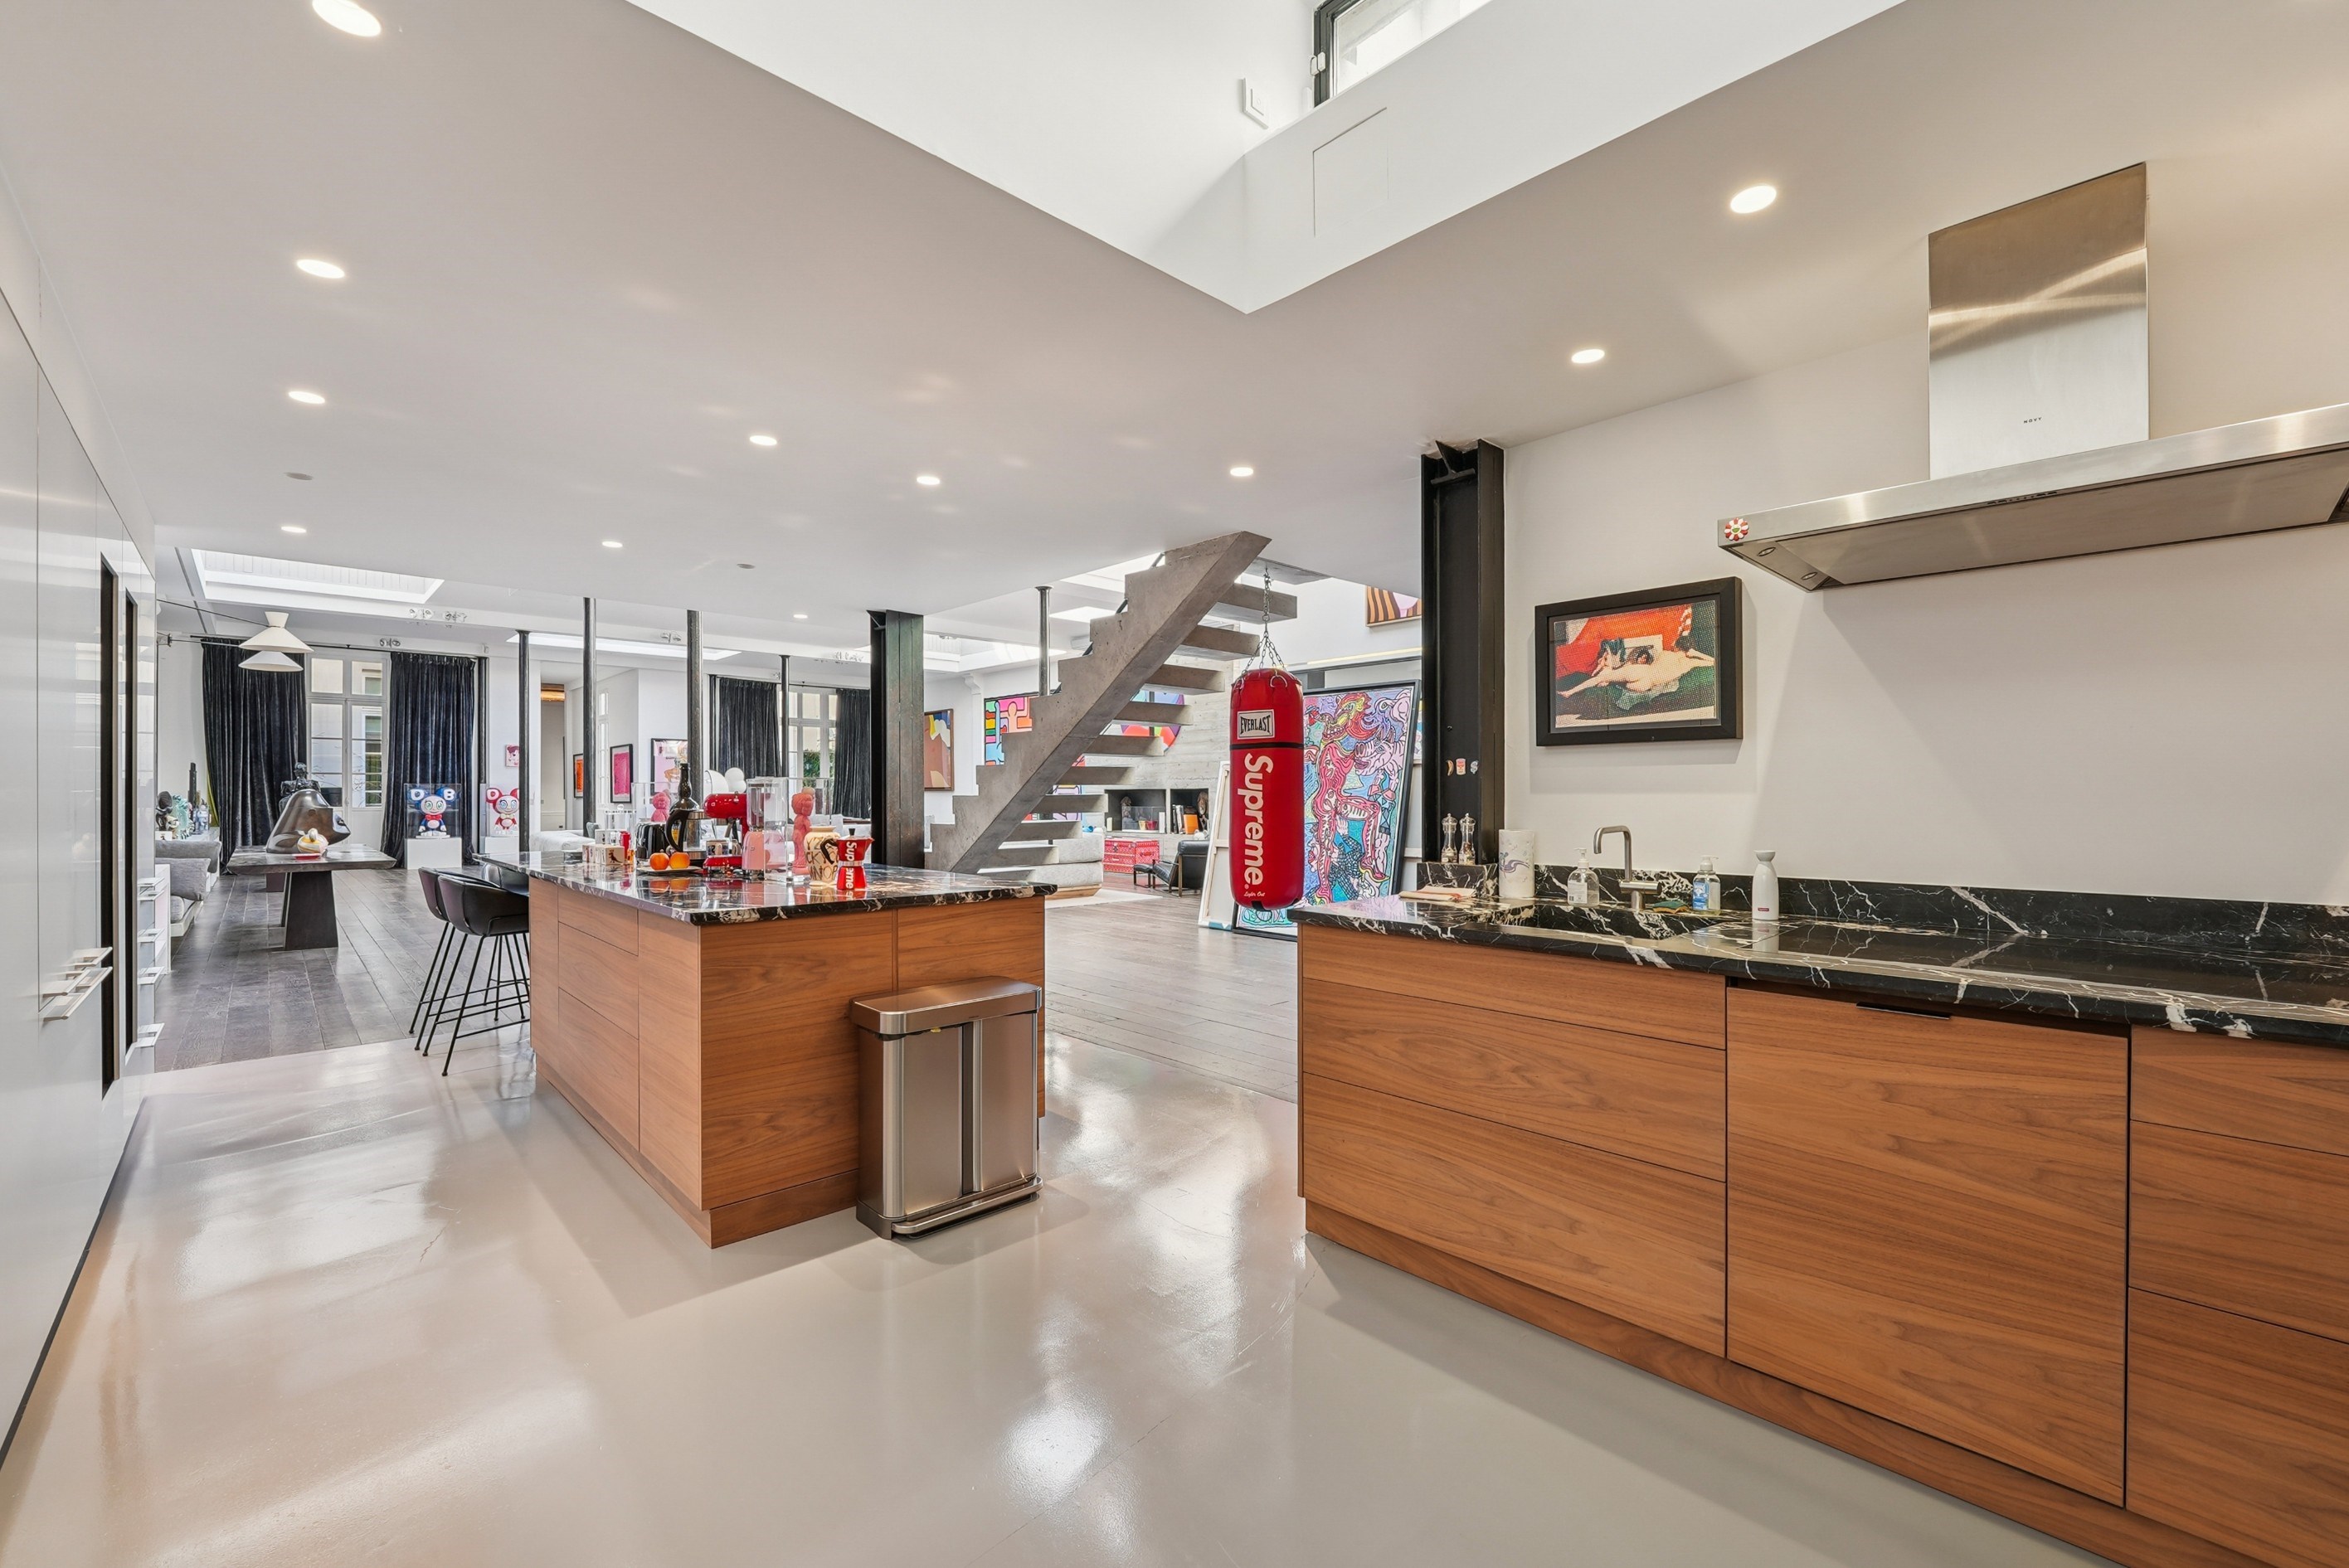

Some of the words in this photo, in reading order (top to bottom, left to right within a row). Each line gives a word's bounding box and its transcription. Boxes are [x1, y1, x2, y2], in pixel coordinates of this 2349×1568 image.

[1240, 714, 1271, 735] EVERLAST
[411, 789, 425, 801] D
[443, 789, 455, 801] B
[1238, 753, 1274, 886] Supreme
